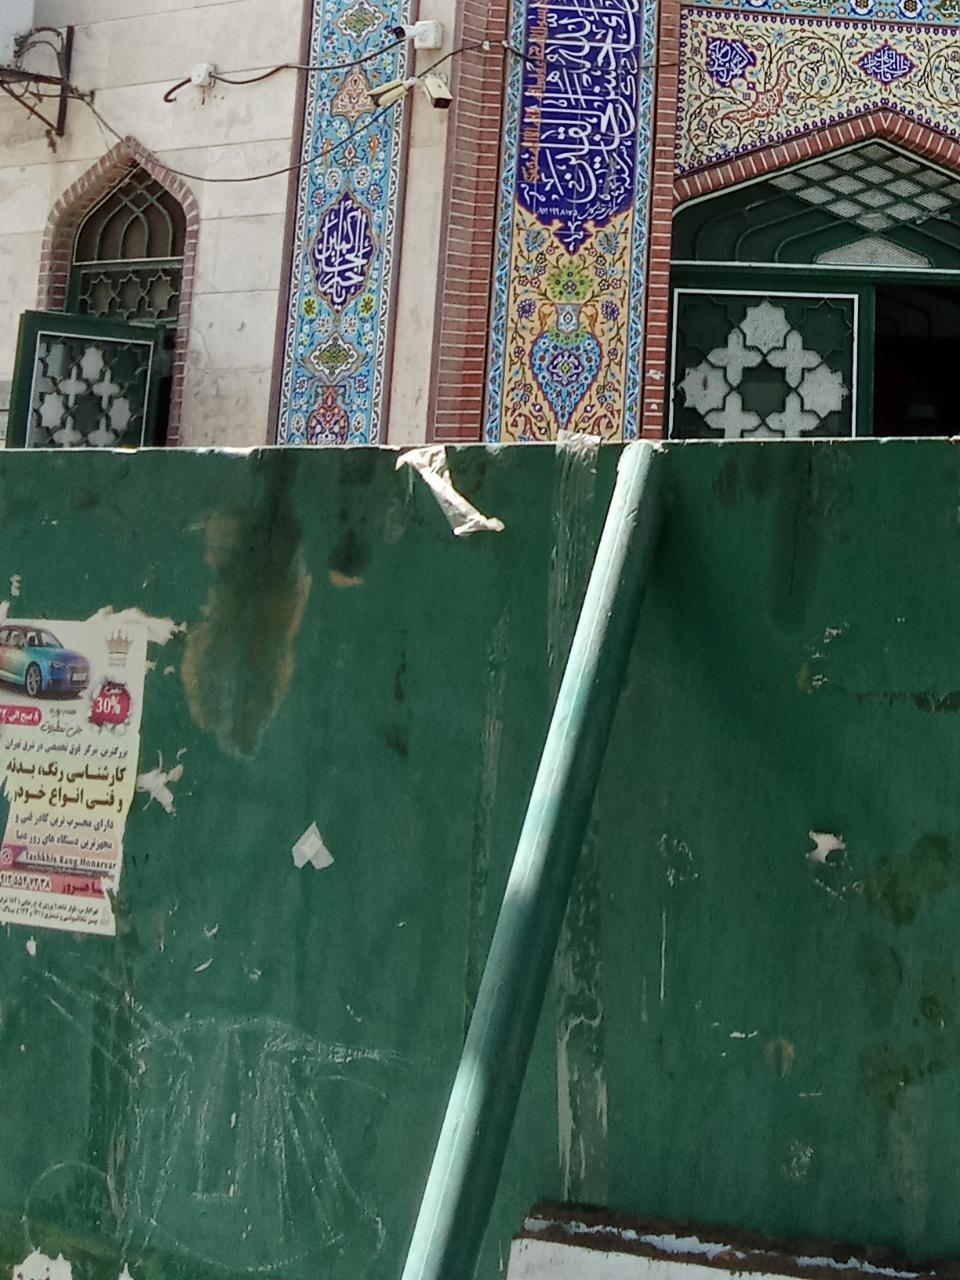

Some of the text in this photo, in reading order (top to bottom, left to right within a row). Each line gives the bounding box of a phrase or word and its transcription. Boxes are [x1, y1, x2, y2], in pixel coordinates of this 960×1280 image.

[95, 696, 121, 714] 30%
[66, 763, 126, 787] کارشناسی
[48, 786, 84, 808] انواع
[86, 788, 115, 810] فنی
